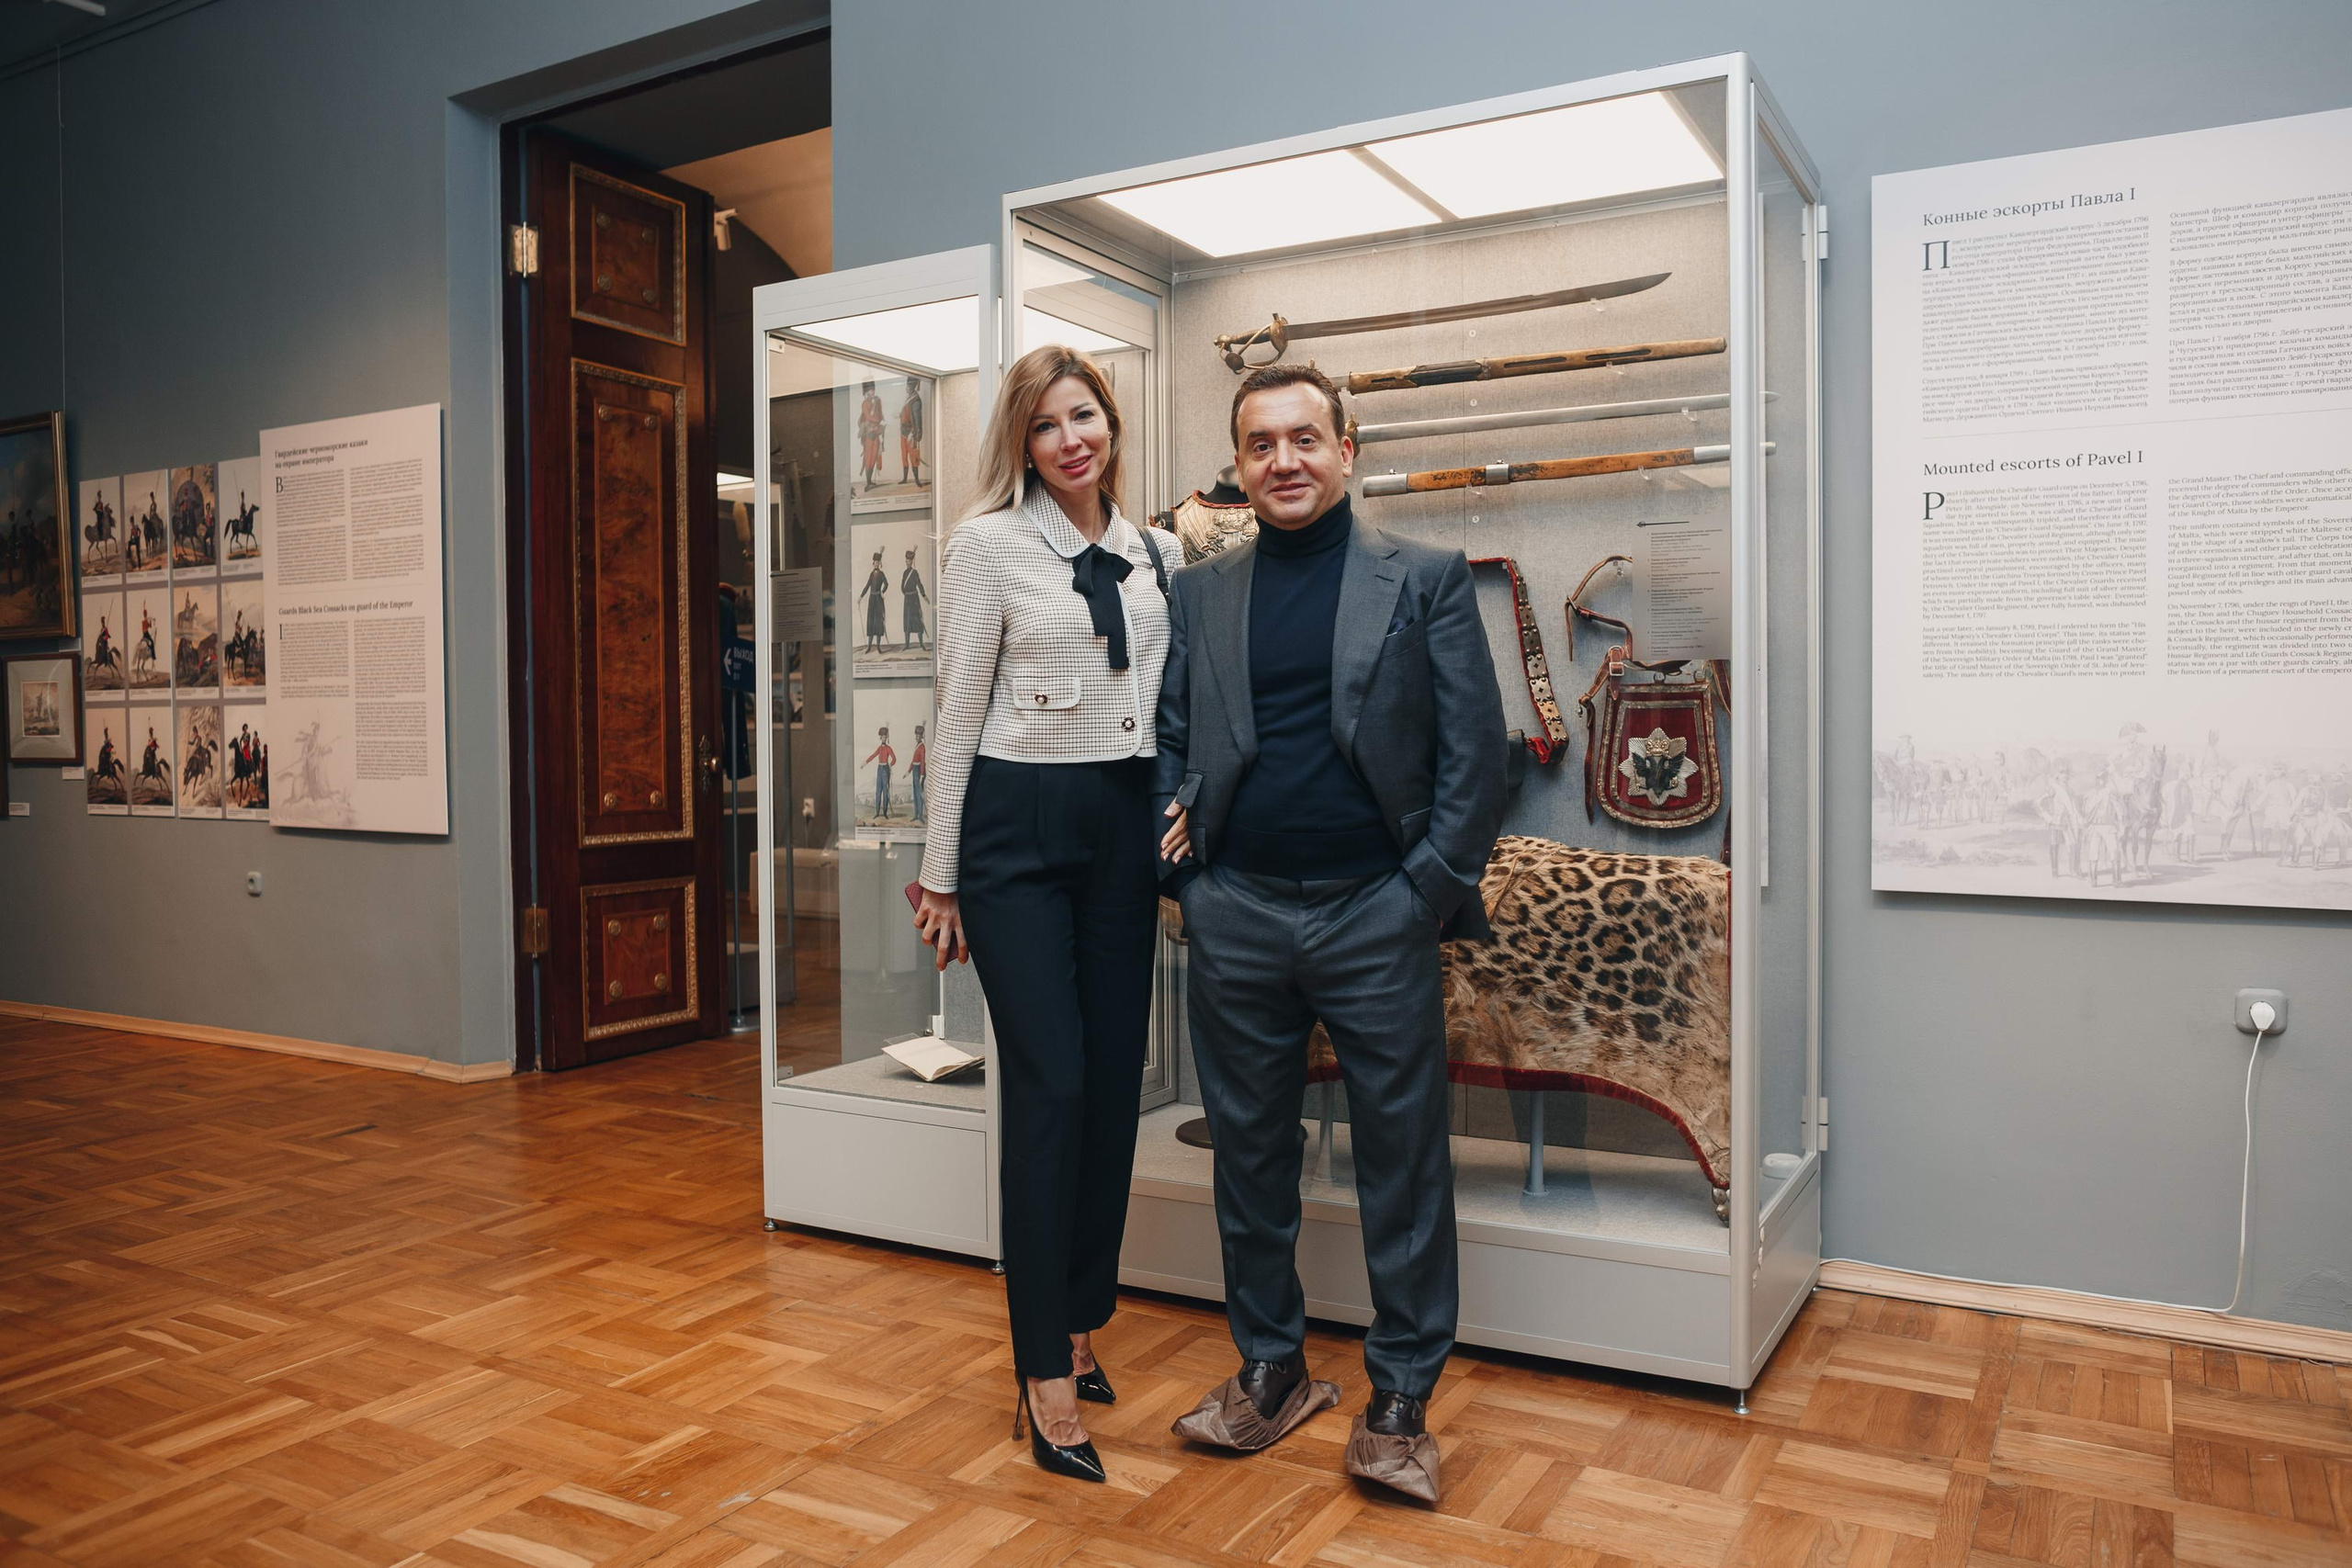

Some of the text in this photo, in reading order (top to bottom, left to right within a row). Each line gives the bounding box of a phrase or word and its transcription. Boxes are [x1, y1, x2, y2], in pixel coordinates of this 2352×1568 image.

[1924, 187, 2134, 226] Конные эскорты Павла I
[1924, 450, 2142, 475] Mounted escorts of Pavel I
[2199, 546, 2242, 554] ceremonies
[2282, 544, 2307, 552] palace
[2167, 563, 2212, 572] reorganized
[2238, 562, 2275, 570] regiment.
[2167, 589, 2189, 597] posed
[2217, 586, 2243, 594] nobles.
[278, 606, 298, 615] Guards
[298, 605, 312, 615] Black
[312, 604, 322, 614] Sea
[322, 604, 348, 613] Cossacks
[356, 603, 371, 613] guard
[372, 601, 379, 609] of
[379, 600, 389, 609] the
[389, 600, 413, 611] Emperor
[2282, 616, 2317, 625] regiment
[2167, 643, 2207, 651] Eventually,
[2279, 640, 2309, 649] divided
[733, 647, 753, 663] ВЫХОД
[2193, 650, 2228, 660] Regiment
